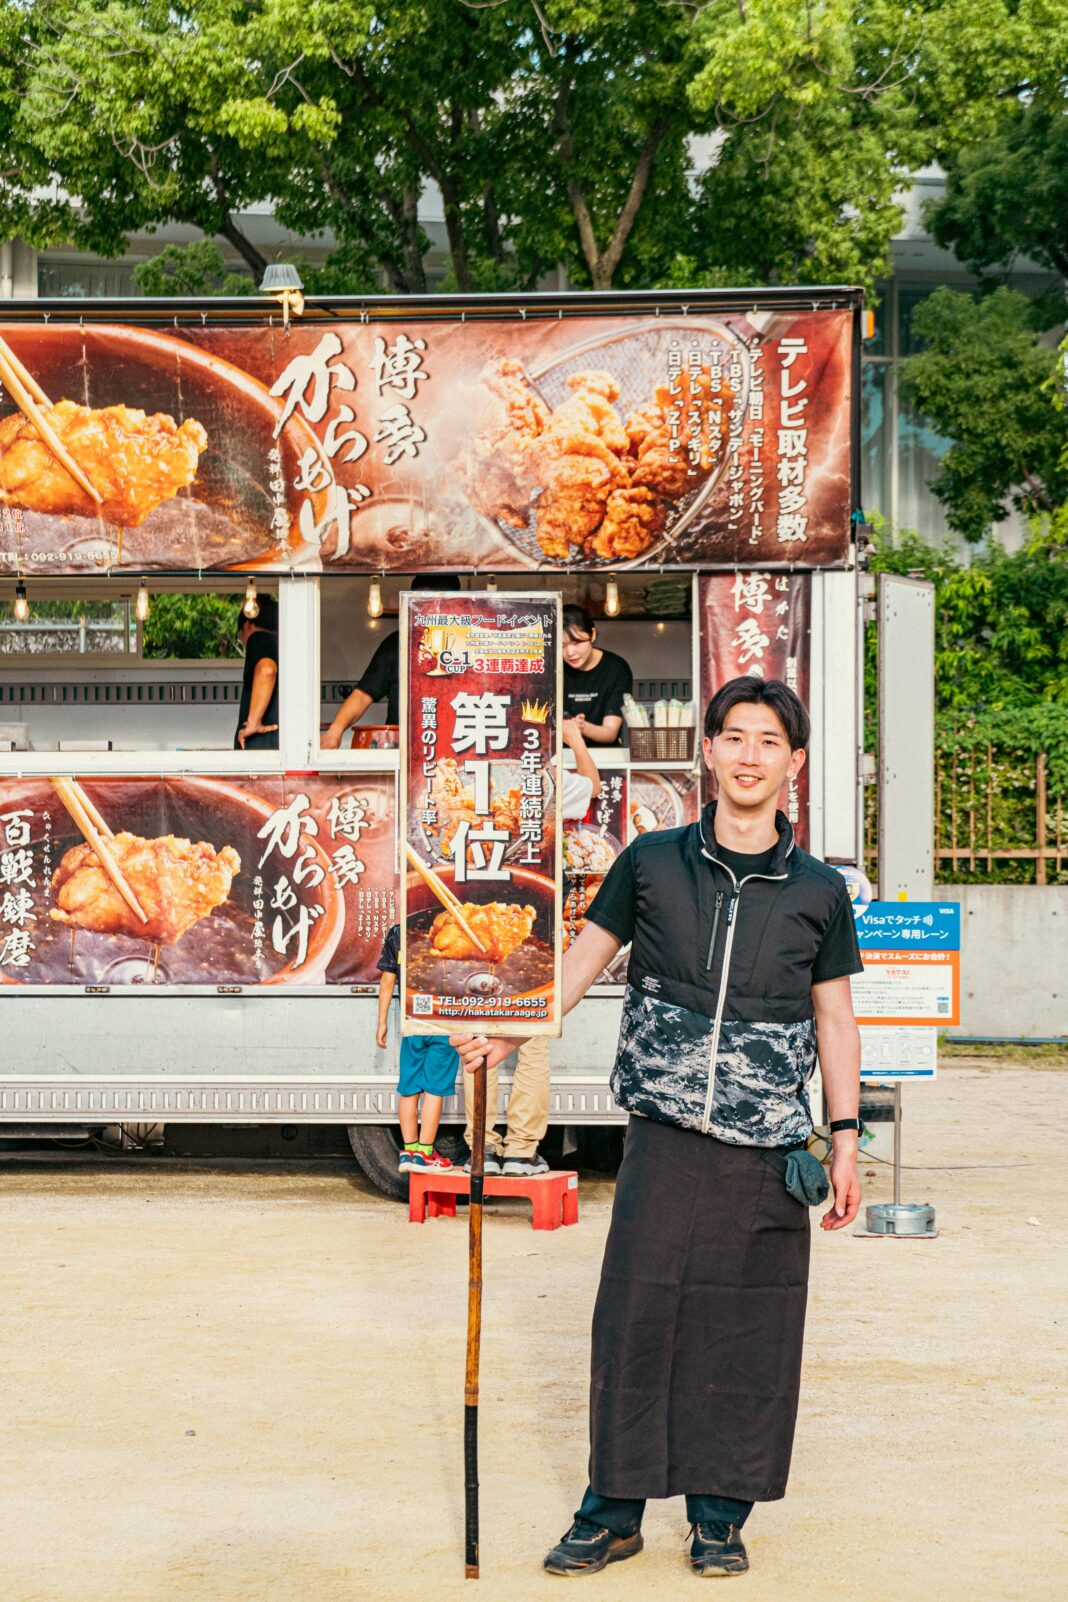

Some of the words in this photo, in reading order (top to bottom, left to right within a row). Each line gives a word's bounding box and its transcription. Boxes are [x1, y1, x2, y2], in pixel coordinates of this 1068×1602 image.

[368, 334, 431, 465] 博多
[268, 332, 373, 562] からあげ
[777, 337, 809, 543] テレビ取材多数
[414, 613, 553, 628] 九州最大級フードイベント
[439, 651, 471, 666] C-1
[446, 665, 467, 673] CUP
[473, 658, 545, 674] 3連覇達成
[450, 692, 511, 882] 第1位
[519, 728, 543, 864] 3年連続売上
[327, 795, 370, 890] 博多
[257, 793, 325, 970] からあげ
[862, 915, 921, 925] Visaでタッチ
[437, 996, 546, 1007] TEL:092-919-6655
[438, 1008, 547, 1018] http://hakatakaraage.jp
